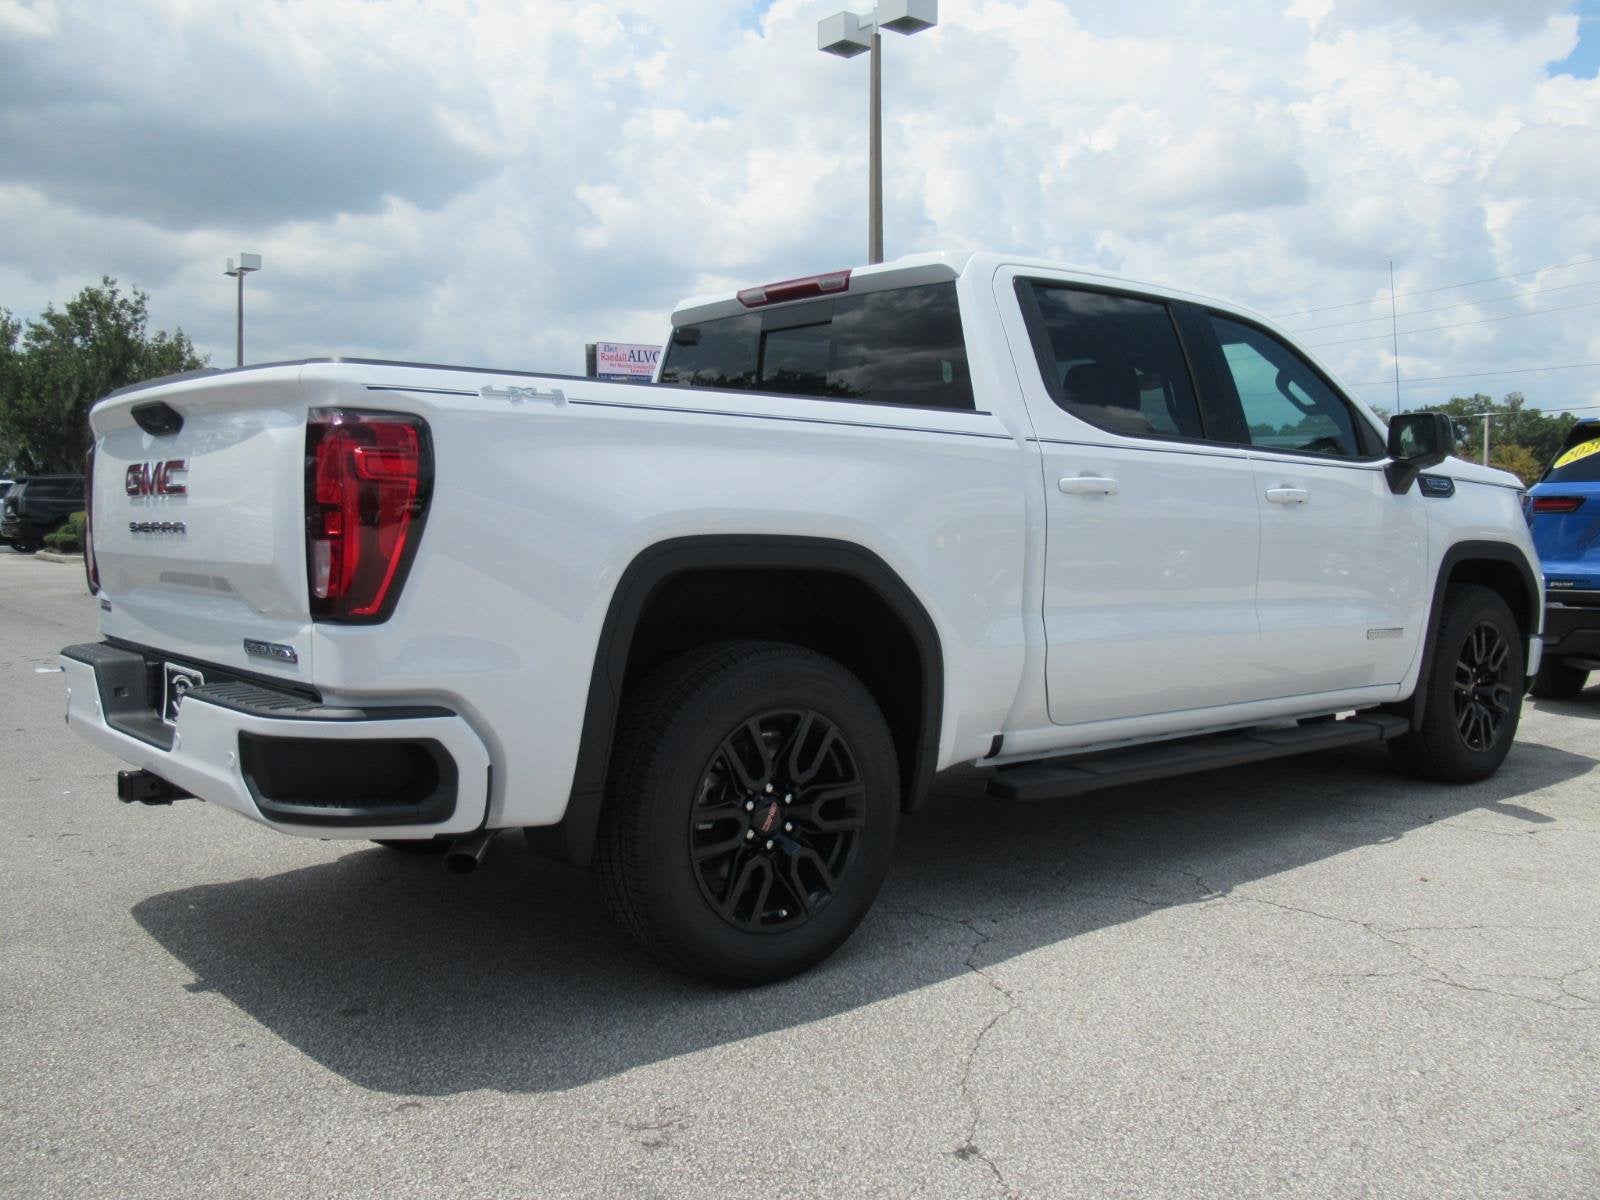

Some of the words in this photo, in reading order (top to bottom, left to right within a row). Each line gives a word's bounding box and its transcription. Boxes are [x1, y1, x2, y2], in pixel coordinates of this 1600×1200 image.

[600, 352, 626, 362] Randall
[126, 460, 188, 496] GMC
[129, 522, 187, 534] SIERRA
